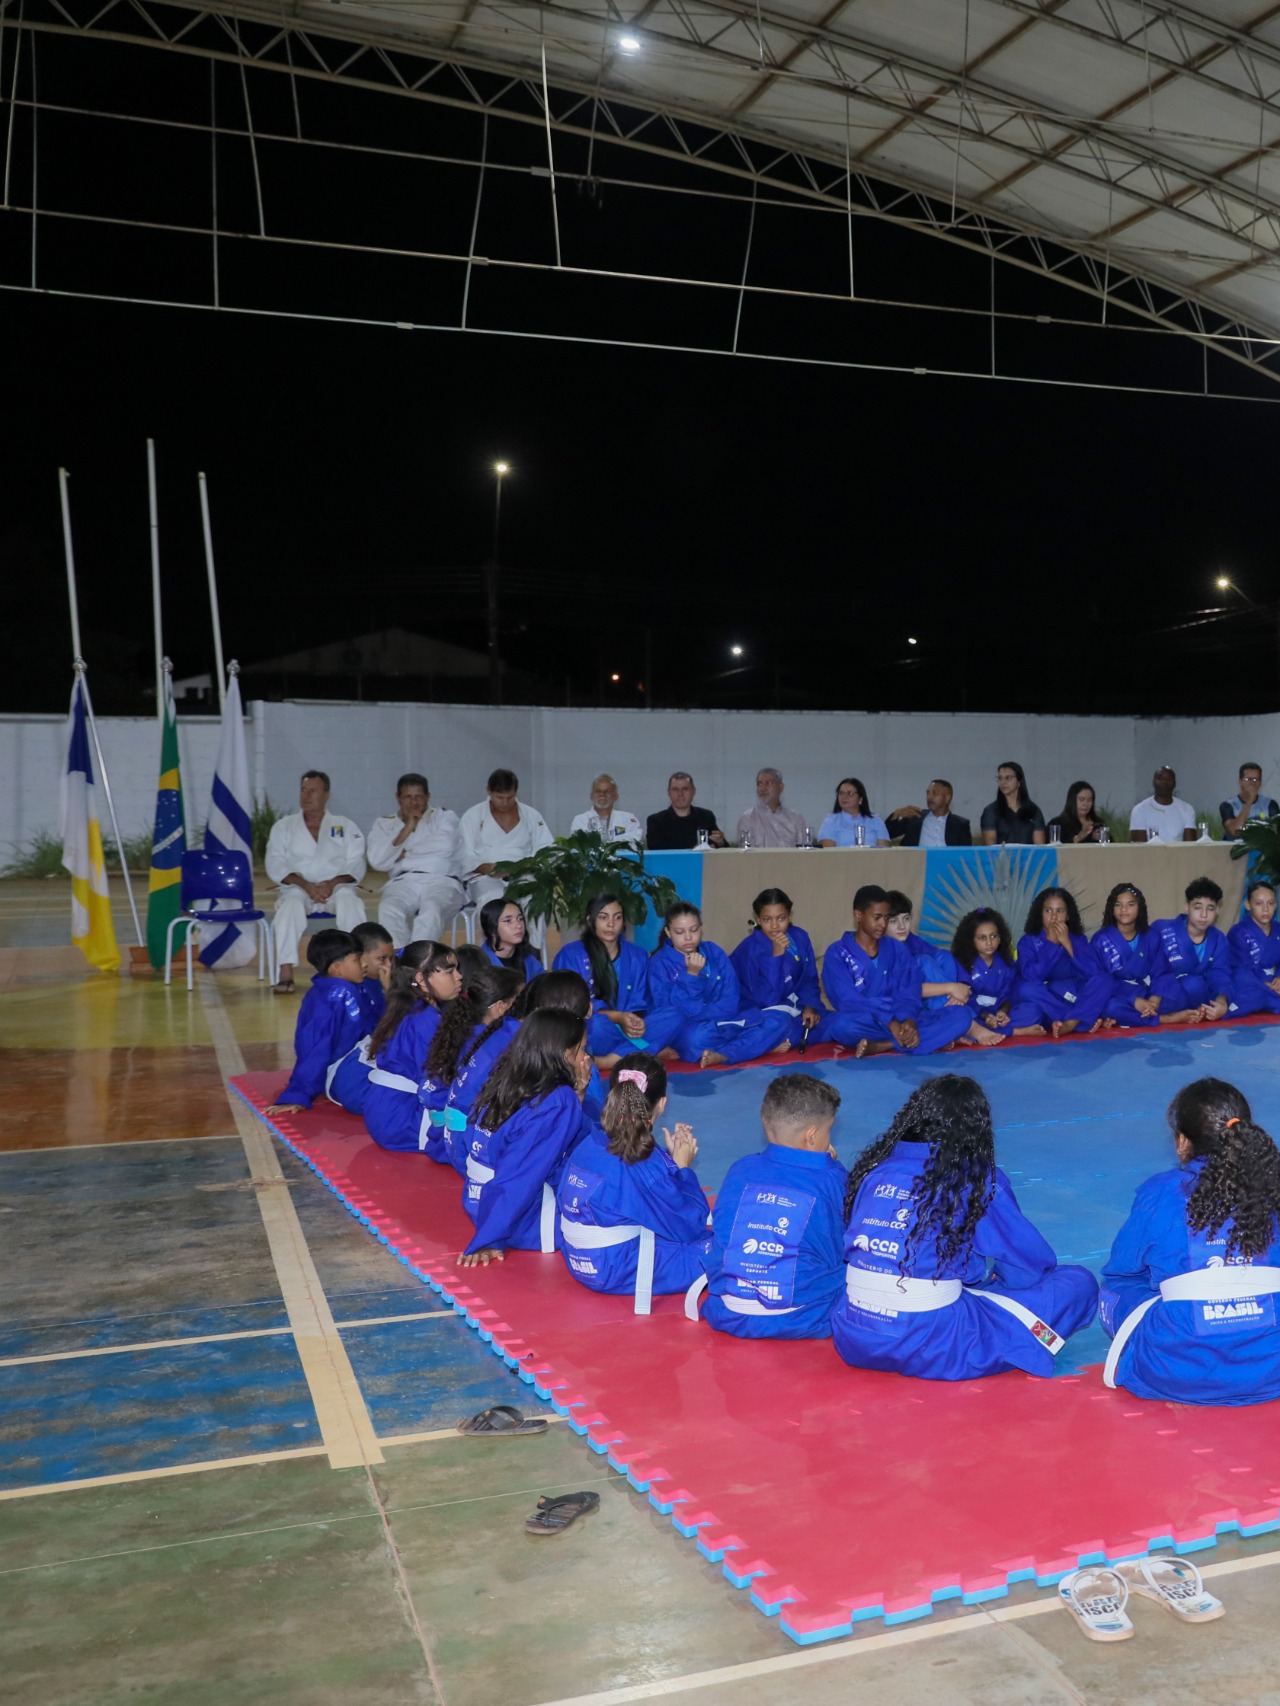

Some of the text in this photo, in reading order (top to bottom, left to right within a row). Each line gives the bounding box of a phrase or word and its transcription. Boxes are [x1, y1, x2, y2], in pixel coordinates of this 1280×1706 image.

[747, 1222, 788, 1236] Instituto CCR
[759, 1241, 784, 1254] CCR
[869, 1238, 899, 1255] CCR
[1203, 1302, 1263, 1320] BRASIL
